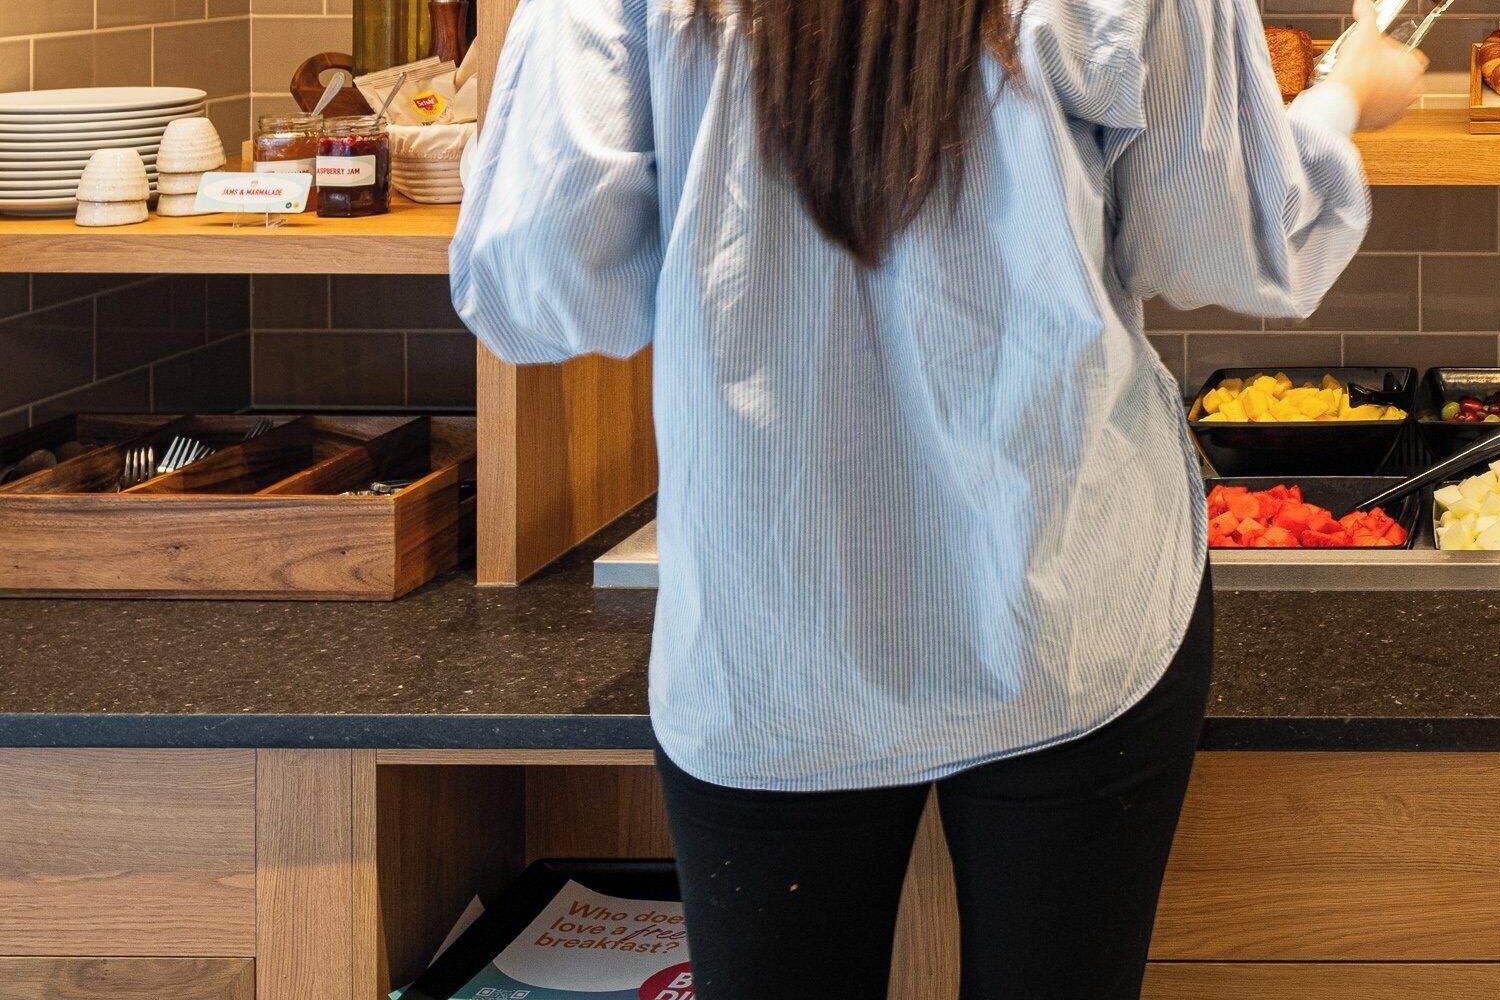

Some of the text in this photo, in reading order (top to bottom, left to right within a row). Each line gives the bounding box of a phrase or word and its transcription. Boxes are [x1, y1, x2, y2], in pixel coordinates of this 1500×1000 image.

[316, 167, 345, 176] ASPBERRY
[346, 167, 361, 176] JAM
[221, 188, 284, 196] JAMS & MARMALADE
[568, 900, 686, 926] Who doe
[550, 916, 687, 943] love a free
[533, 931, 681, 955] breakfast?
